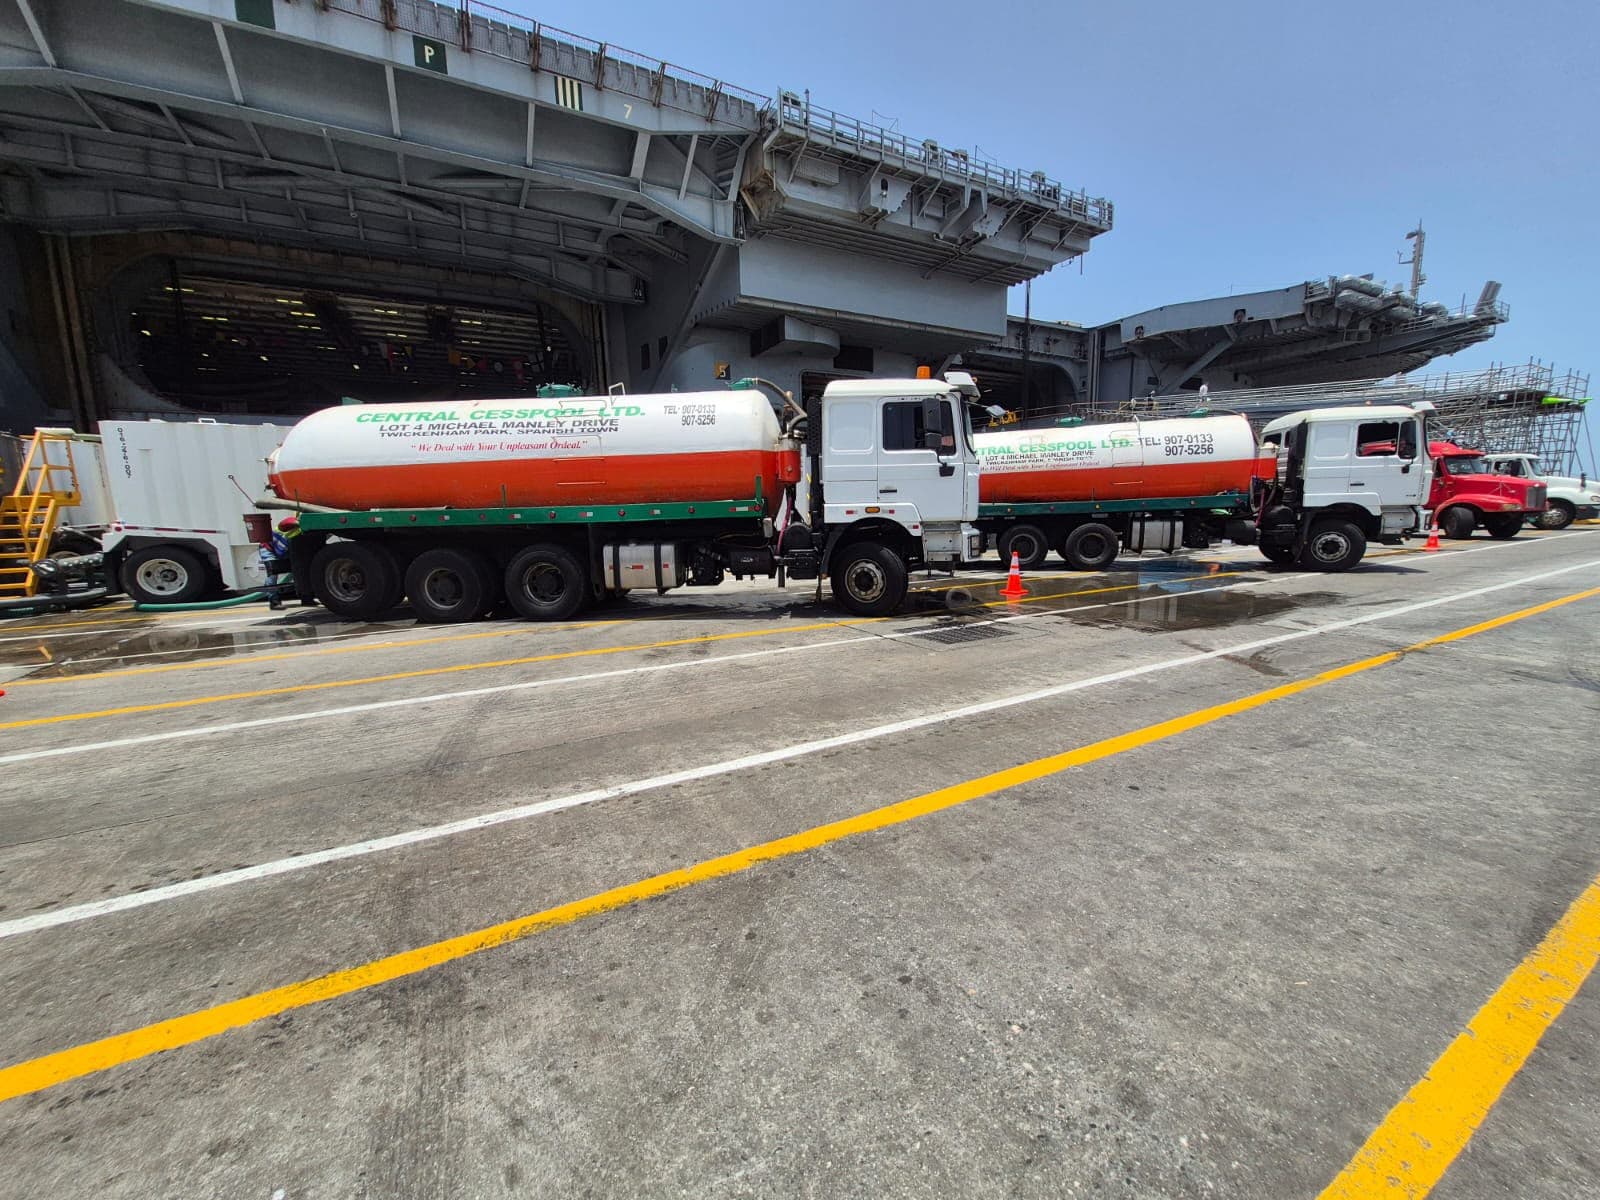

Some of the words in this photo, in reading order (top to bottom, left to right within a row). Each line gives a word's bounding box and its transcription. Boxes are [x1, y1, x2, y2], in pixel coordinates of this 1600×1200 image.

[424, 44, 435, 64] P
[623, 103, 633, 120] 7
[719, 365, 726, 378] 5
[356, 411, 460, 423] CENTRAL
[598, 406, 646, 417] LTD.
[682, 404, 716, 414] 907-0133
[380, 424, 410, 432] LOT
[427, 422, 497, 431] MICHAEL
[502, 420, 566, 429] MANLEY
[572, 418, 620, 428] DRIVE
[681, 414, 716, 426] 907-5256
[380, 430, 470, 438] TWICKENHAM
[516, 427, 574, 435] SPANISH
[433, 443, 455, 452] Deal
[456, 443, 475, 451] with
[478, 443, 497, 451] Your
[499, 441, 548, 452] Unpleasant
[1019, 440, 1097, 453] CESSPOOL
[1138, 436, 1162, 447] TEL:
[1164, 433, 1214, 445] 907-0133
[1006, 452, 1039, 460] MICHAEL
[1164, 444, 1215, 457] 907-5256
